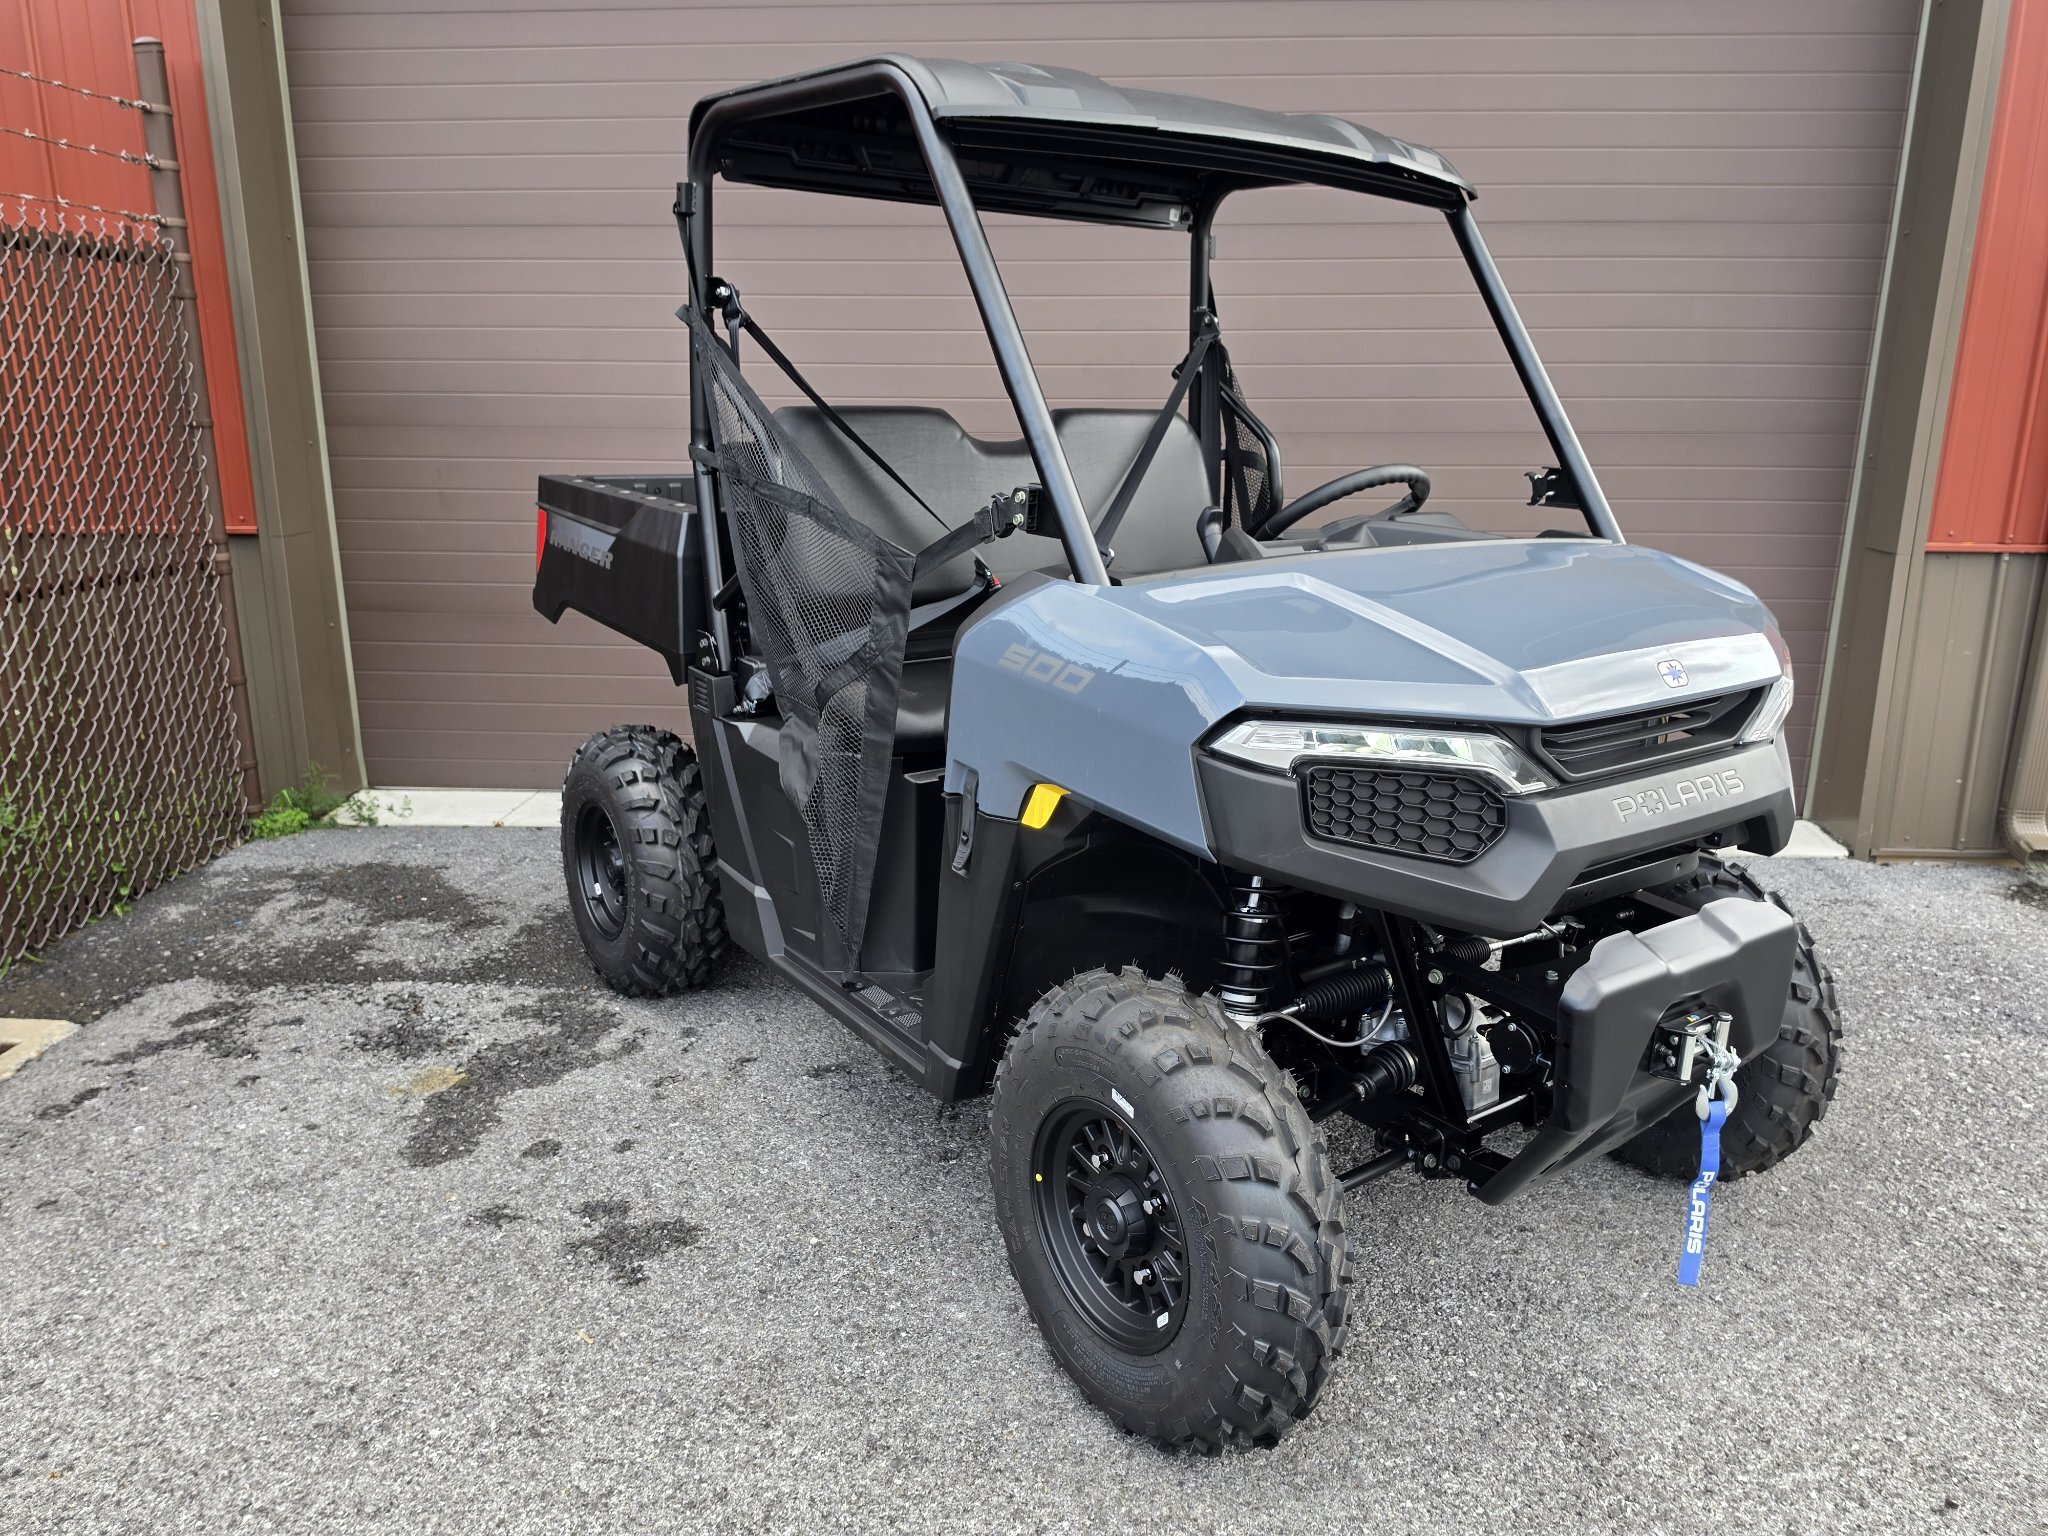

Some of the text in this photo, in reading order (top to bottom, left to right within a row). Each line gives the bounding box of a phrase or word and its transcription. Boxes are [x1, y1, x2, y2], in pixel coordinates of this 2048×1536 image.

[997, 642, 1096, 695] 500
[1611, 768, 1745, 824] POLARIS
[1686, 1170, 1716, 1255] POLARIS
